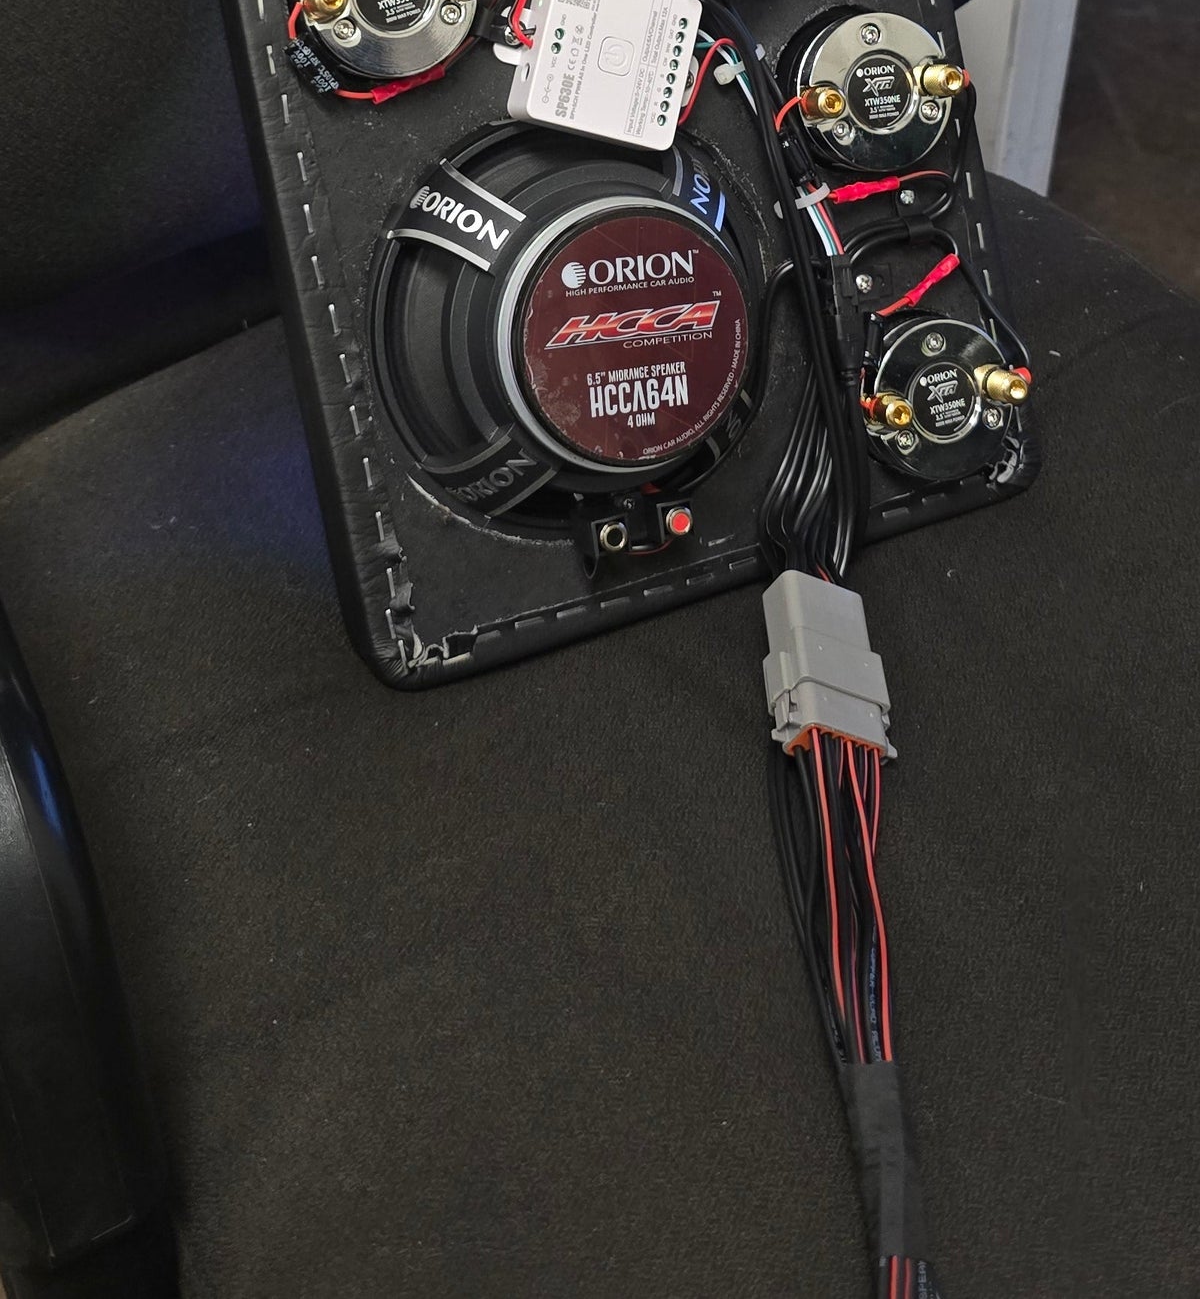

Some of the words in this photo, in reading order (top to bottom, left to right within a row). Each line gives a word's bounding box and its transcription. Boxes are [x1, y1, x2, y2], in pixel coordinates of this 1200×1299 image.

[587, 11, 598, 40] Controller
[863, 64, 896, 76] ORION
[555, 73, 575, 118] SP630E
[864, 94, 901, 107] XTW350NE
[422, 191, 510, 250] ORION
[589, 250, 694, 285] ORION
[565, 288, 587, 298] HIGH
[588, 282, 648, 295] PERFORMANCE
[650, 278, 667, 287] CAR
[670, 276, 695, 286] AUDIO
[546, 300, 721, 348] HCCA
[623, 331, 713, 349] COMPETITION
[734, 340, 741, 350] IN
[731, 349, 741, 369] MADE
[587, 371, 606, 386] 6.5"
[608, 365, 650, 383] MIDRANGE
[650, 361, 687, 377] SPEAKER
[927, 368, 958, 384] ORION
[589, 374, 689, 418] HCCA64N
[718, 372, 734, 403] RESERVED
[702, 401, 721, 421] RIGHTS
[929, 398, 966, 415] XTW350NE
[627, 415, 634, 429] 4
[635, 412, 656, 428] OHM
[694, 420, 705, 432] ALL
[642, 444, 663, 455] ORION
[663, 438, 677, 450] CAR
